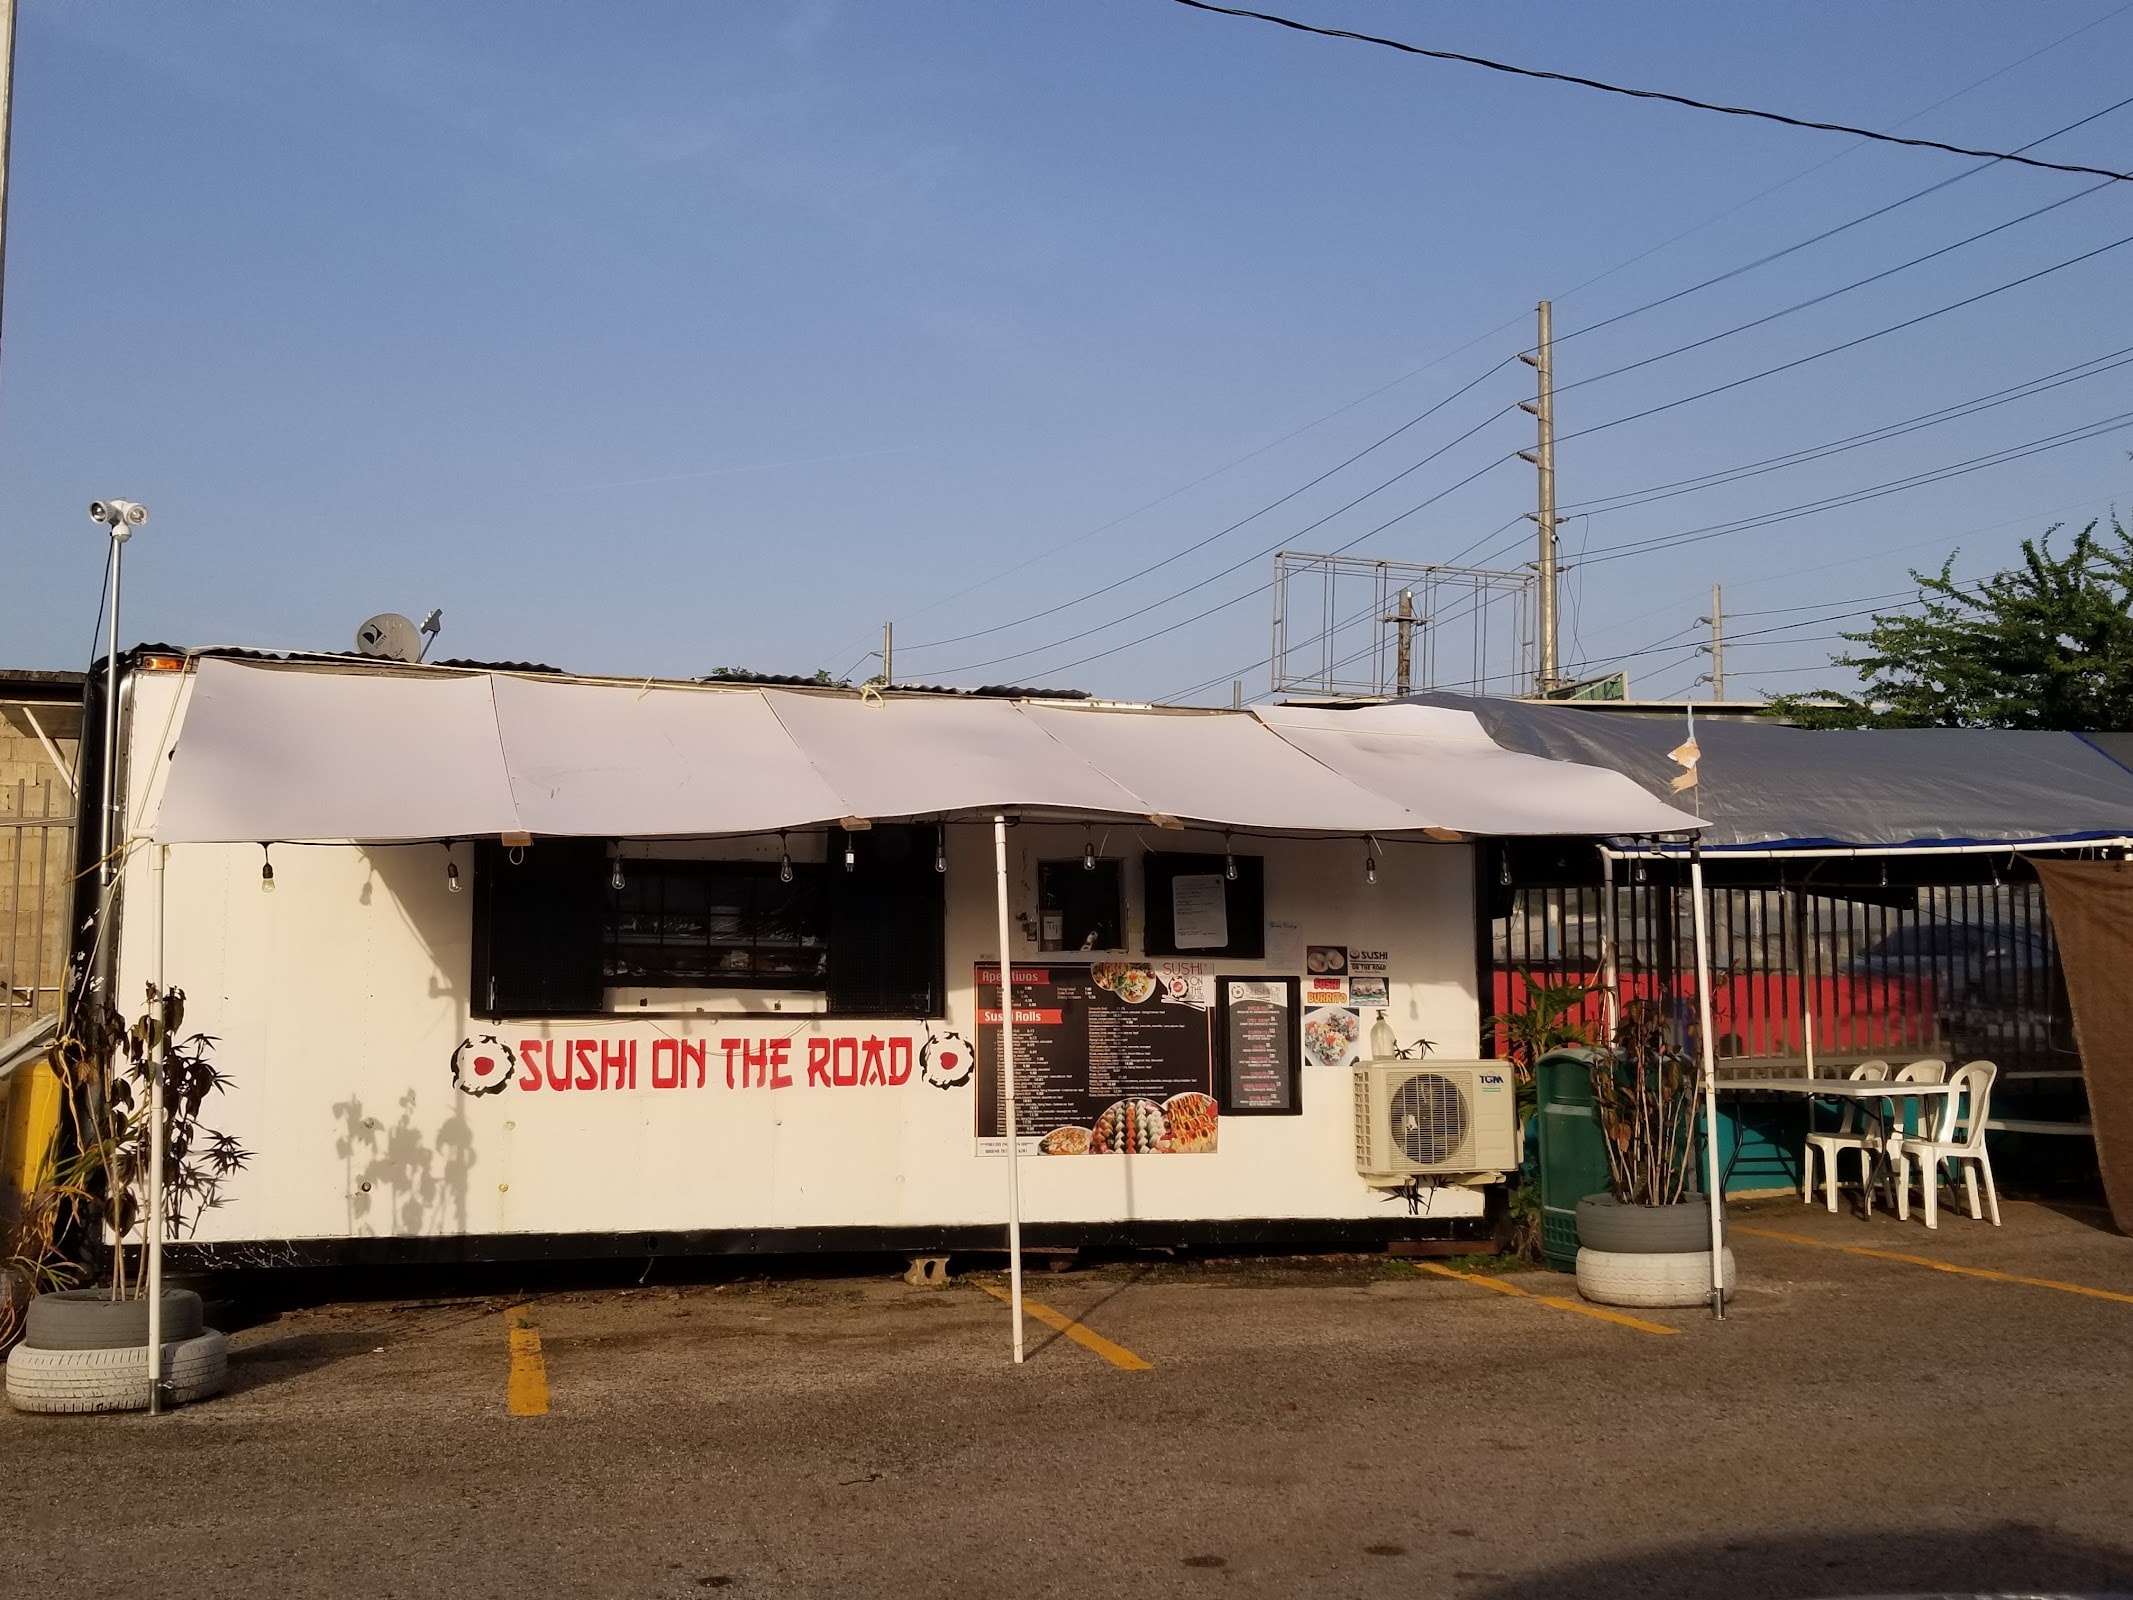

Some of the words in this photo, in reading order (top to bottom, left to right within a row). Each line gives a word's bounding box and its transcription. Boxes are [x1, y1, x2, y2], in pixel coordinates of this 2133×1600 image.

[1361, 951, 1388, 960] SUSHI
[1162, 962, 1203, 975] SUSHI
[982, 971, 1038, 984] Apetivos
[1190, 976, 1202, 986] ON
[1313, 978, 1341, 989] SUSHI
[1307, 991, 1347, 1003] BURRITO
[984, 1011, 1014, 1022] Susi
[1016, 1011, 1041, 1022] Rolls
[518, 1038, 637, 1092] SUSHI
[652, 1038, 706, 1090] ON
[720, 1038, 794, 1090] THE
[806, 1034, 913, 1089] ROAD
[1479, 1075, 1504, 1084] TGM
